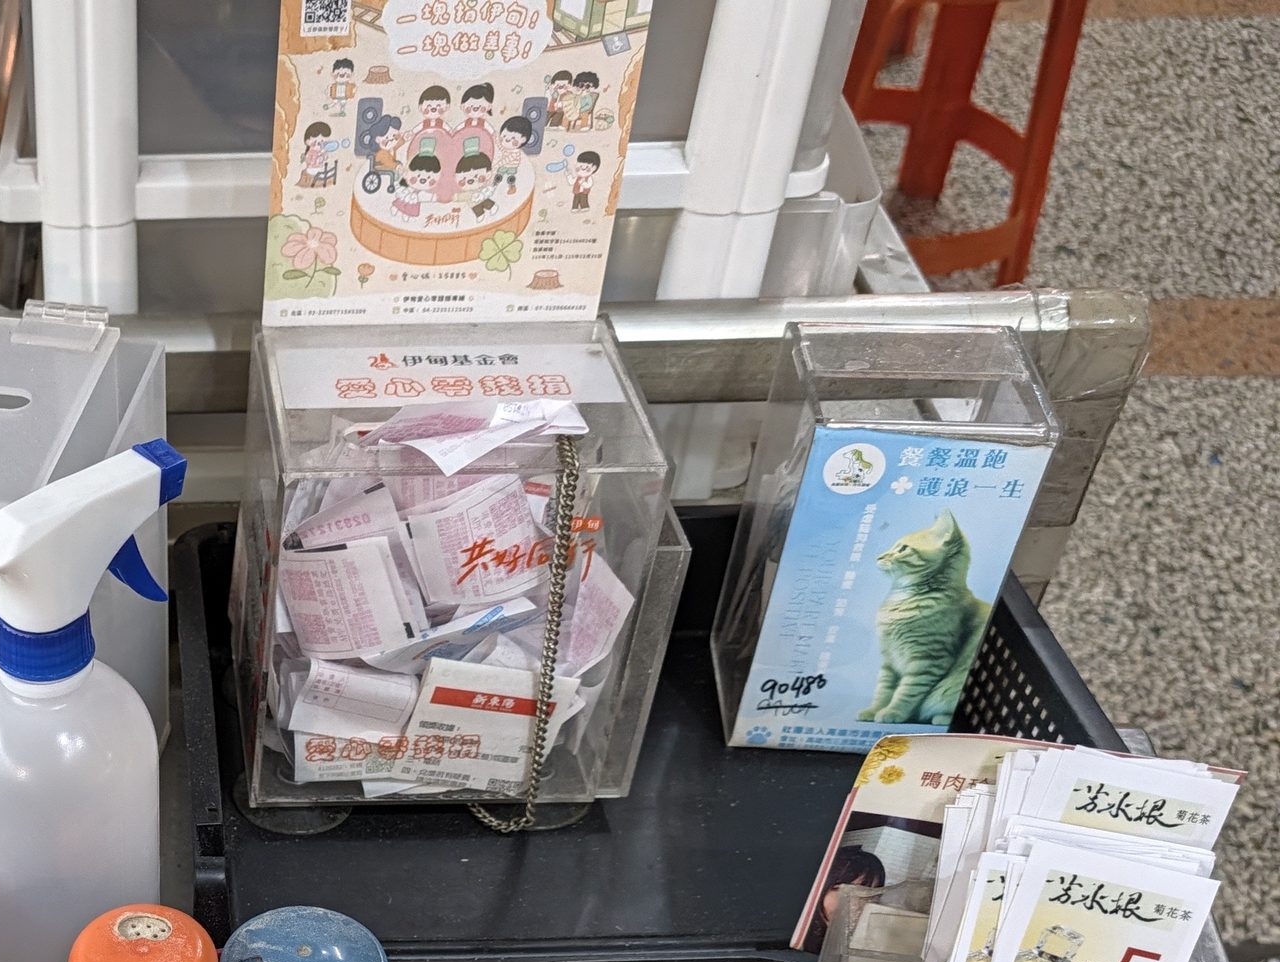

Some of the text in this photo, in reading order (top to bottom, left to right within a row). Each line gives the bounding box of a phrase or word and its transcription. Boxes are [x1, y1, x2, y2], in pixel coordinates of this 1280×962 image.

[401, 353, 520, 367] 伊甸基金會
[335, 374, 572, 399] 愛心零錢捐
[897, 446, 1009, 470] 餐餐溫飽
[916, 477, 1025, 499] 護浪一生
[1175, 809, 1211, 825] 菊花茶
[1152, 902, 1194, 922] 菊花茶
